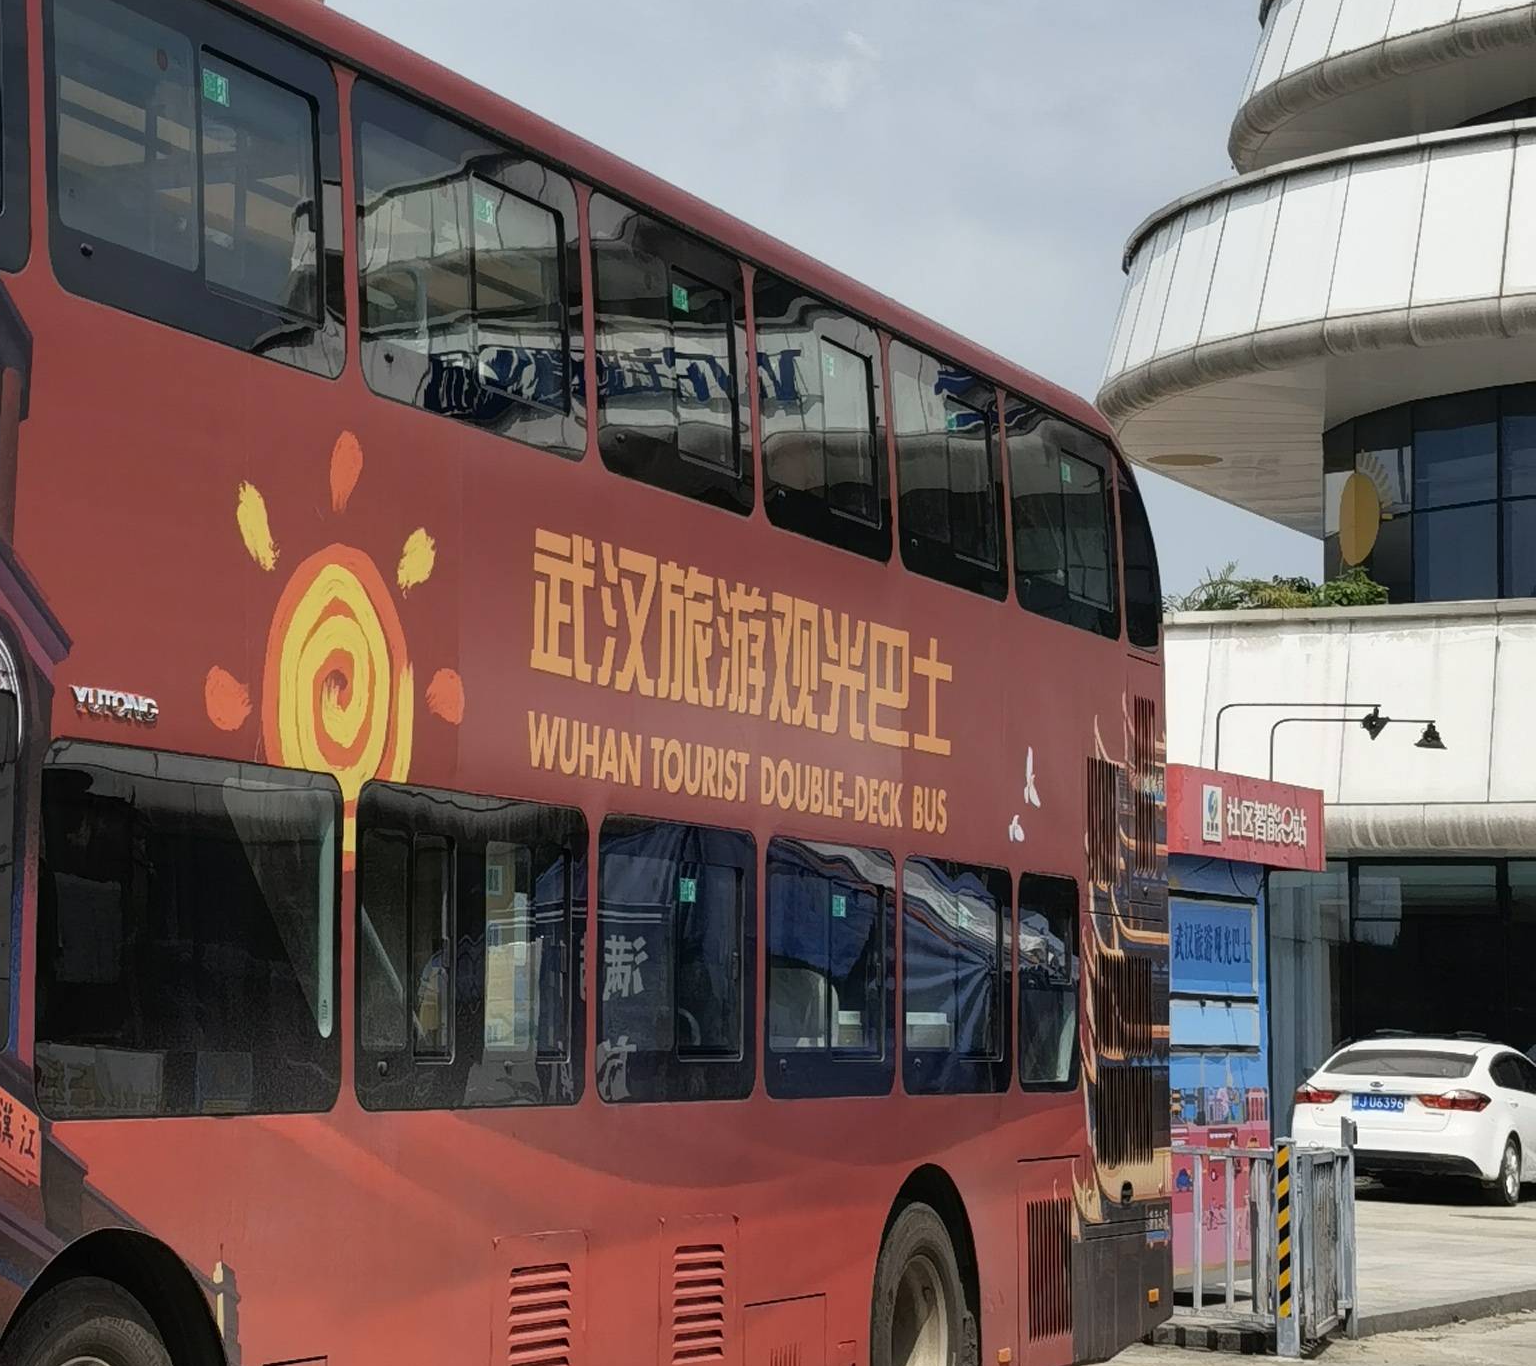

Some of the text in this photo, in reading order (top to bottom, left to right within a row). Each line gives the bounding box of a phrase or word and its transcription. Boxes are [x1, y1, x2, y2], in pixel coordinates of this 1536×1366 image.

[530, 528, 952, 756] 武汉旅游观光巴士
[527, 710, 948, 835] WUHAN TOURIST DOUBLE-DECK BUS
